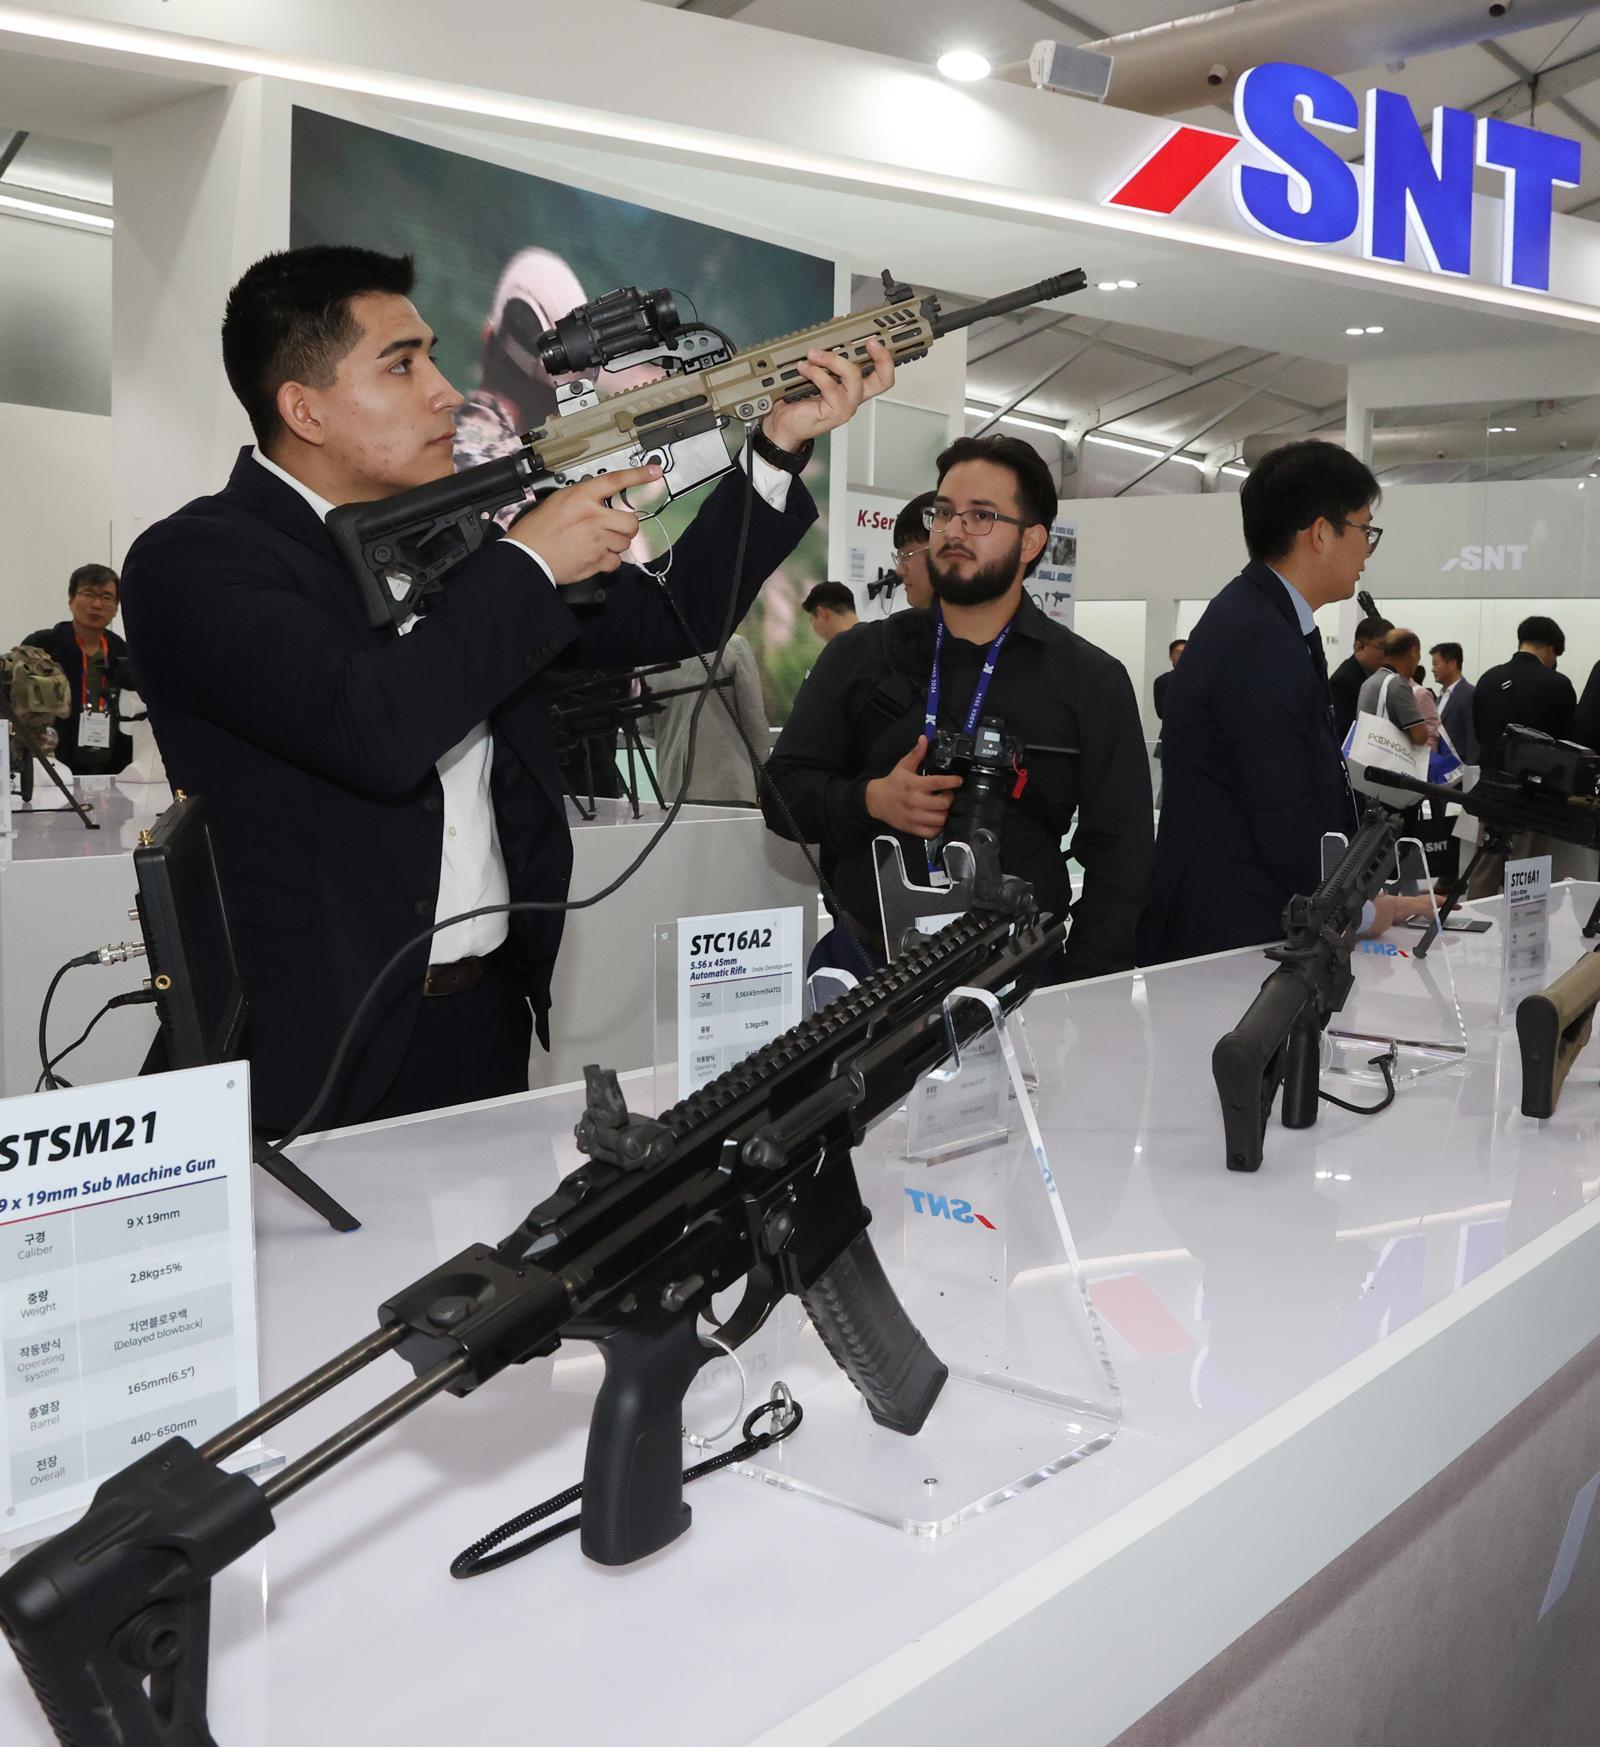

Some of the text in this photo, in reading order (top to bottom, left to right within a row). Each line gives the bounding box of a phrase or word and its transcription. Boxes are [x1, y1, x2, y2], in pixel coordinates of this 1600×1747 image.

[1231, 62, 1581, 291] SNT
[857, 508, 896, 530] K-Ser
[1460, 544, 1528, 571] SNT
[1425, 840, 1448, 853] SNT
[1510, 870, 1540, 888] STC16A1
[690, 928, 772, 956] STC16A2
[690, 961, 707, 970] 5.56
[714, 958, 738, 967] 45mm
[690, 965, 747, 981] Automatic Rifle
[0, 1110, 157, 1172] STSM21
[11, 1198, 22, 1210] x
[26, 1187, 78, 1207] 19mm
[82, 1178, 112, 1196] Sub
[116, 1164, 182, 1189] Machine
[186, 1158, 216, 1174] Gun
[127, 1218, 135, 1228] 9
[147, 1210, 181, 1224] 19mm
[25, 1231, 46, 1245] 구경
[18, 1244, 53, 1260] Caliber
[130, 1262, 183, 1284] 2.8kg±5%
[28, 1290, 49, 1305] 중량
[20, 1302, 57, 1319] Weight
[130, 1309, 188, 1333] 지연블로우백
[114, 1318, 203, 1352] (Delayed blowback)
[20, 1339, 61, 1358] 작동방식
[17, 1353, 65, 1373] Operating
[24, 1366, 60, 1383] system
[29, 1401, 60, 1420] 총열장
[30, 1416, 60, 1431] Barrel
[36, 1455, 58, 1472] 전장
[30, 1468, 66, 1487] Overall
